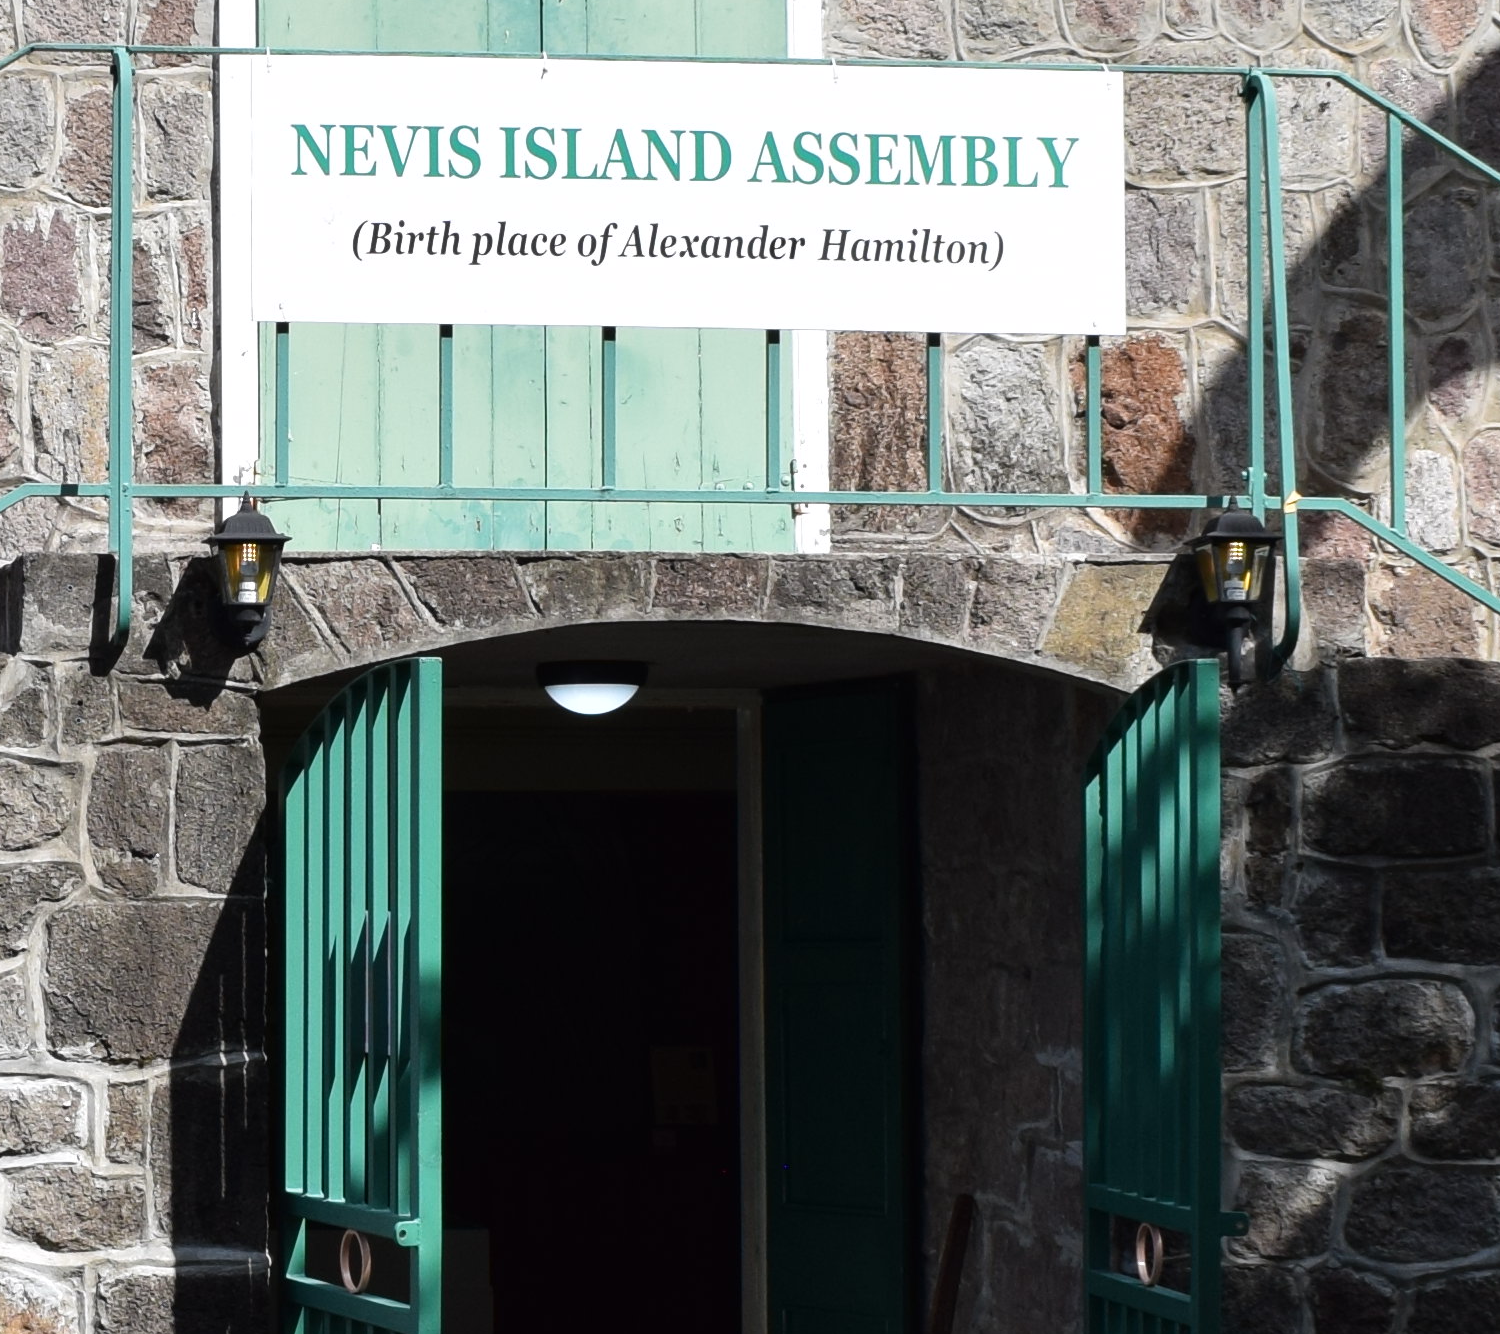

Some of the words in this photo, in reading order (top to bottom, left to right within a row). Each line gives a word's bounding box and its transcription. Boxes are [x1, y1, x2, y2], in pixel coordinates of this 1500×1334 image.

[290, 123, 482, 180] NEVIS
[499, 126, 732, 182] ISLAND
[746, 130, 1080, 189] ASSEMBLY
[352, 219, 462, 262] (Birth
[468, 220, 567, 266] place
[577, 222, 619, 267] of
[617, 222, 806, 260] Alexander
[817, 228, 1004, 272] Hamilton)
